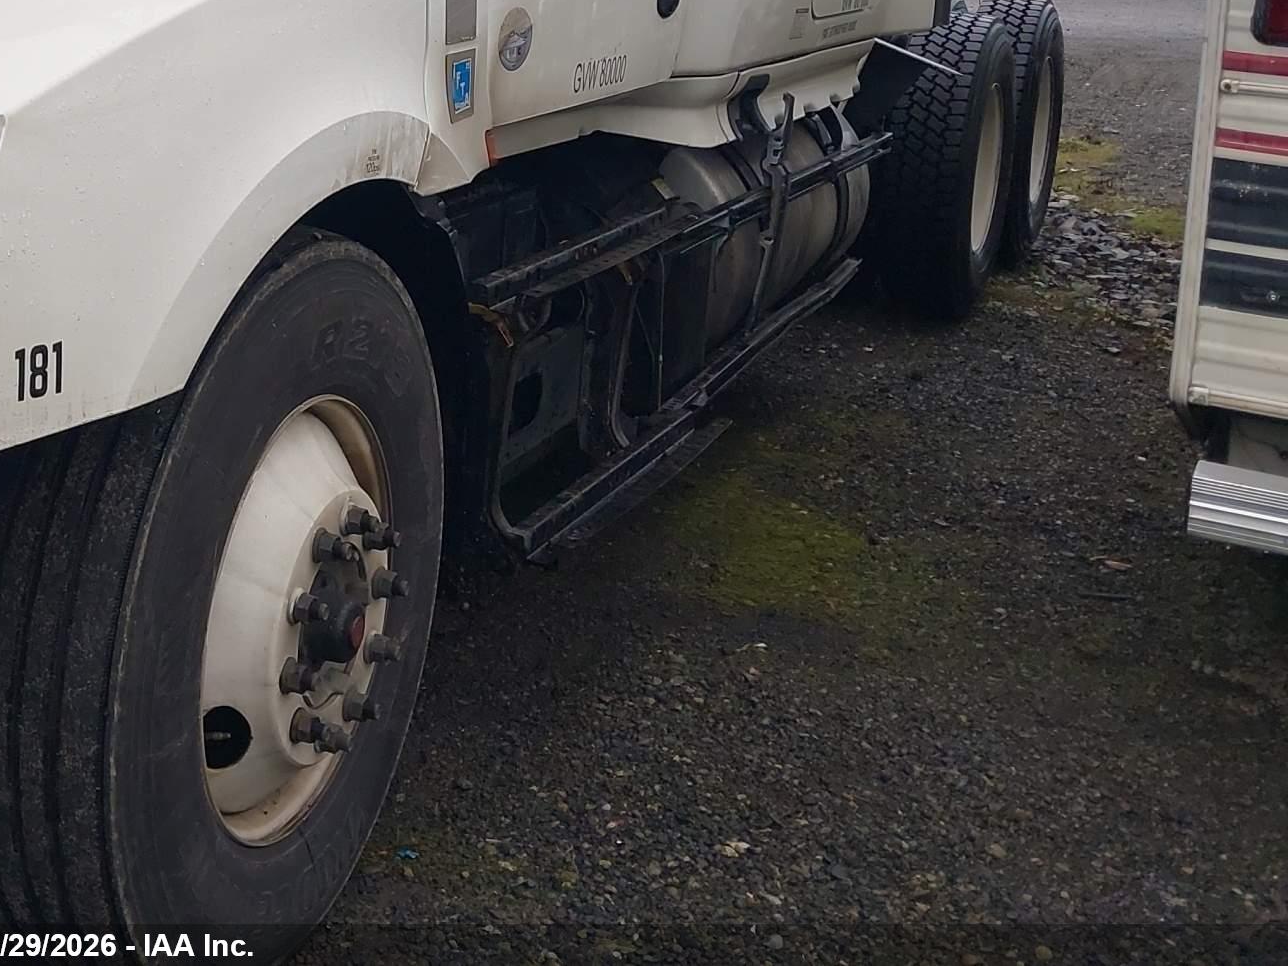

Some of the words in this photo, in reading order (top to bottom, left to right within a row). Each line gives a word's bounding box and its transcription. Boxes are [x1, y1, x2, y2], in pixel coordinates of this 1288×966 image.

[573, 61, 599, 93] GVW
[599, 55, 627, 88] 80000
[14, 340, 63, 402] 181
